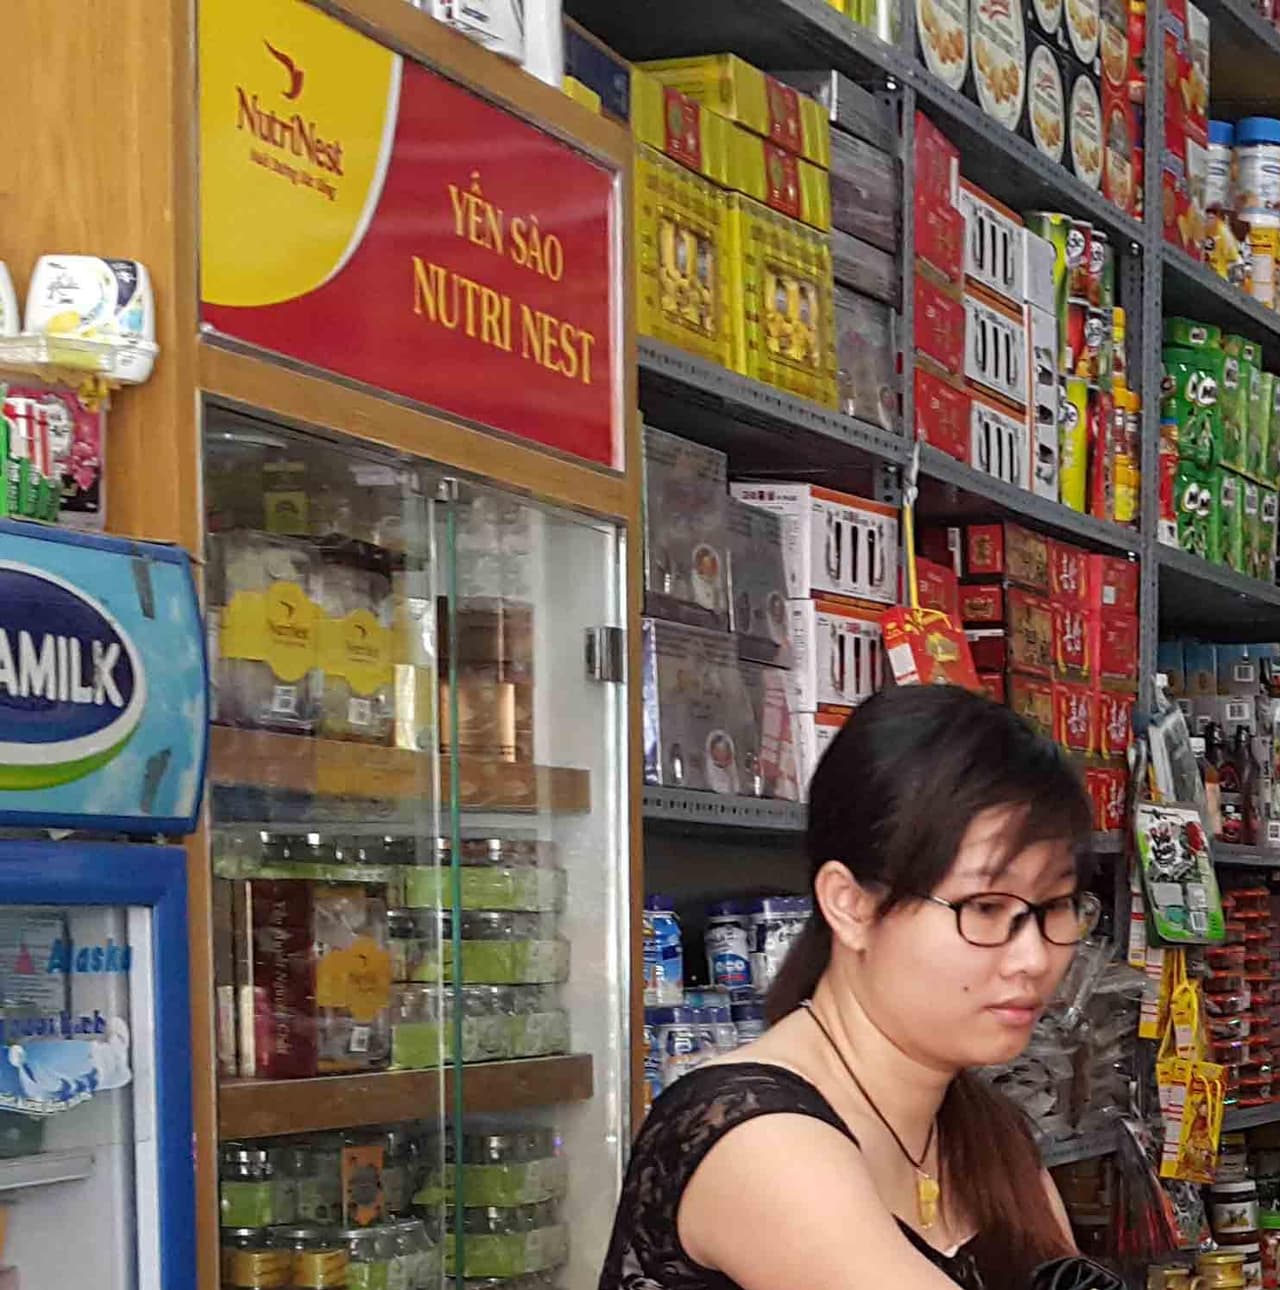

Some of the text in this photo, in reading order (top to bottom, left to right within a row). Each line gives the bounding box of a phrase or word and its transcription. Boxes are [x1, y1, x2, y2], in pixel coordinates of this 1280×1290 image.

[235, 85, 343, 176] NutriNest
[411, 255, 596, 385] NUTRI NEST
